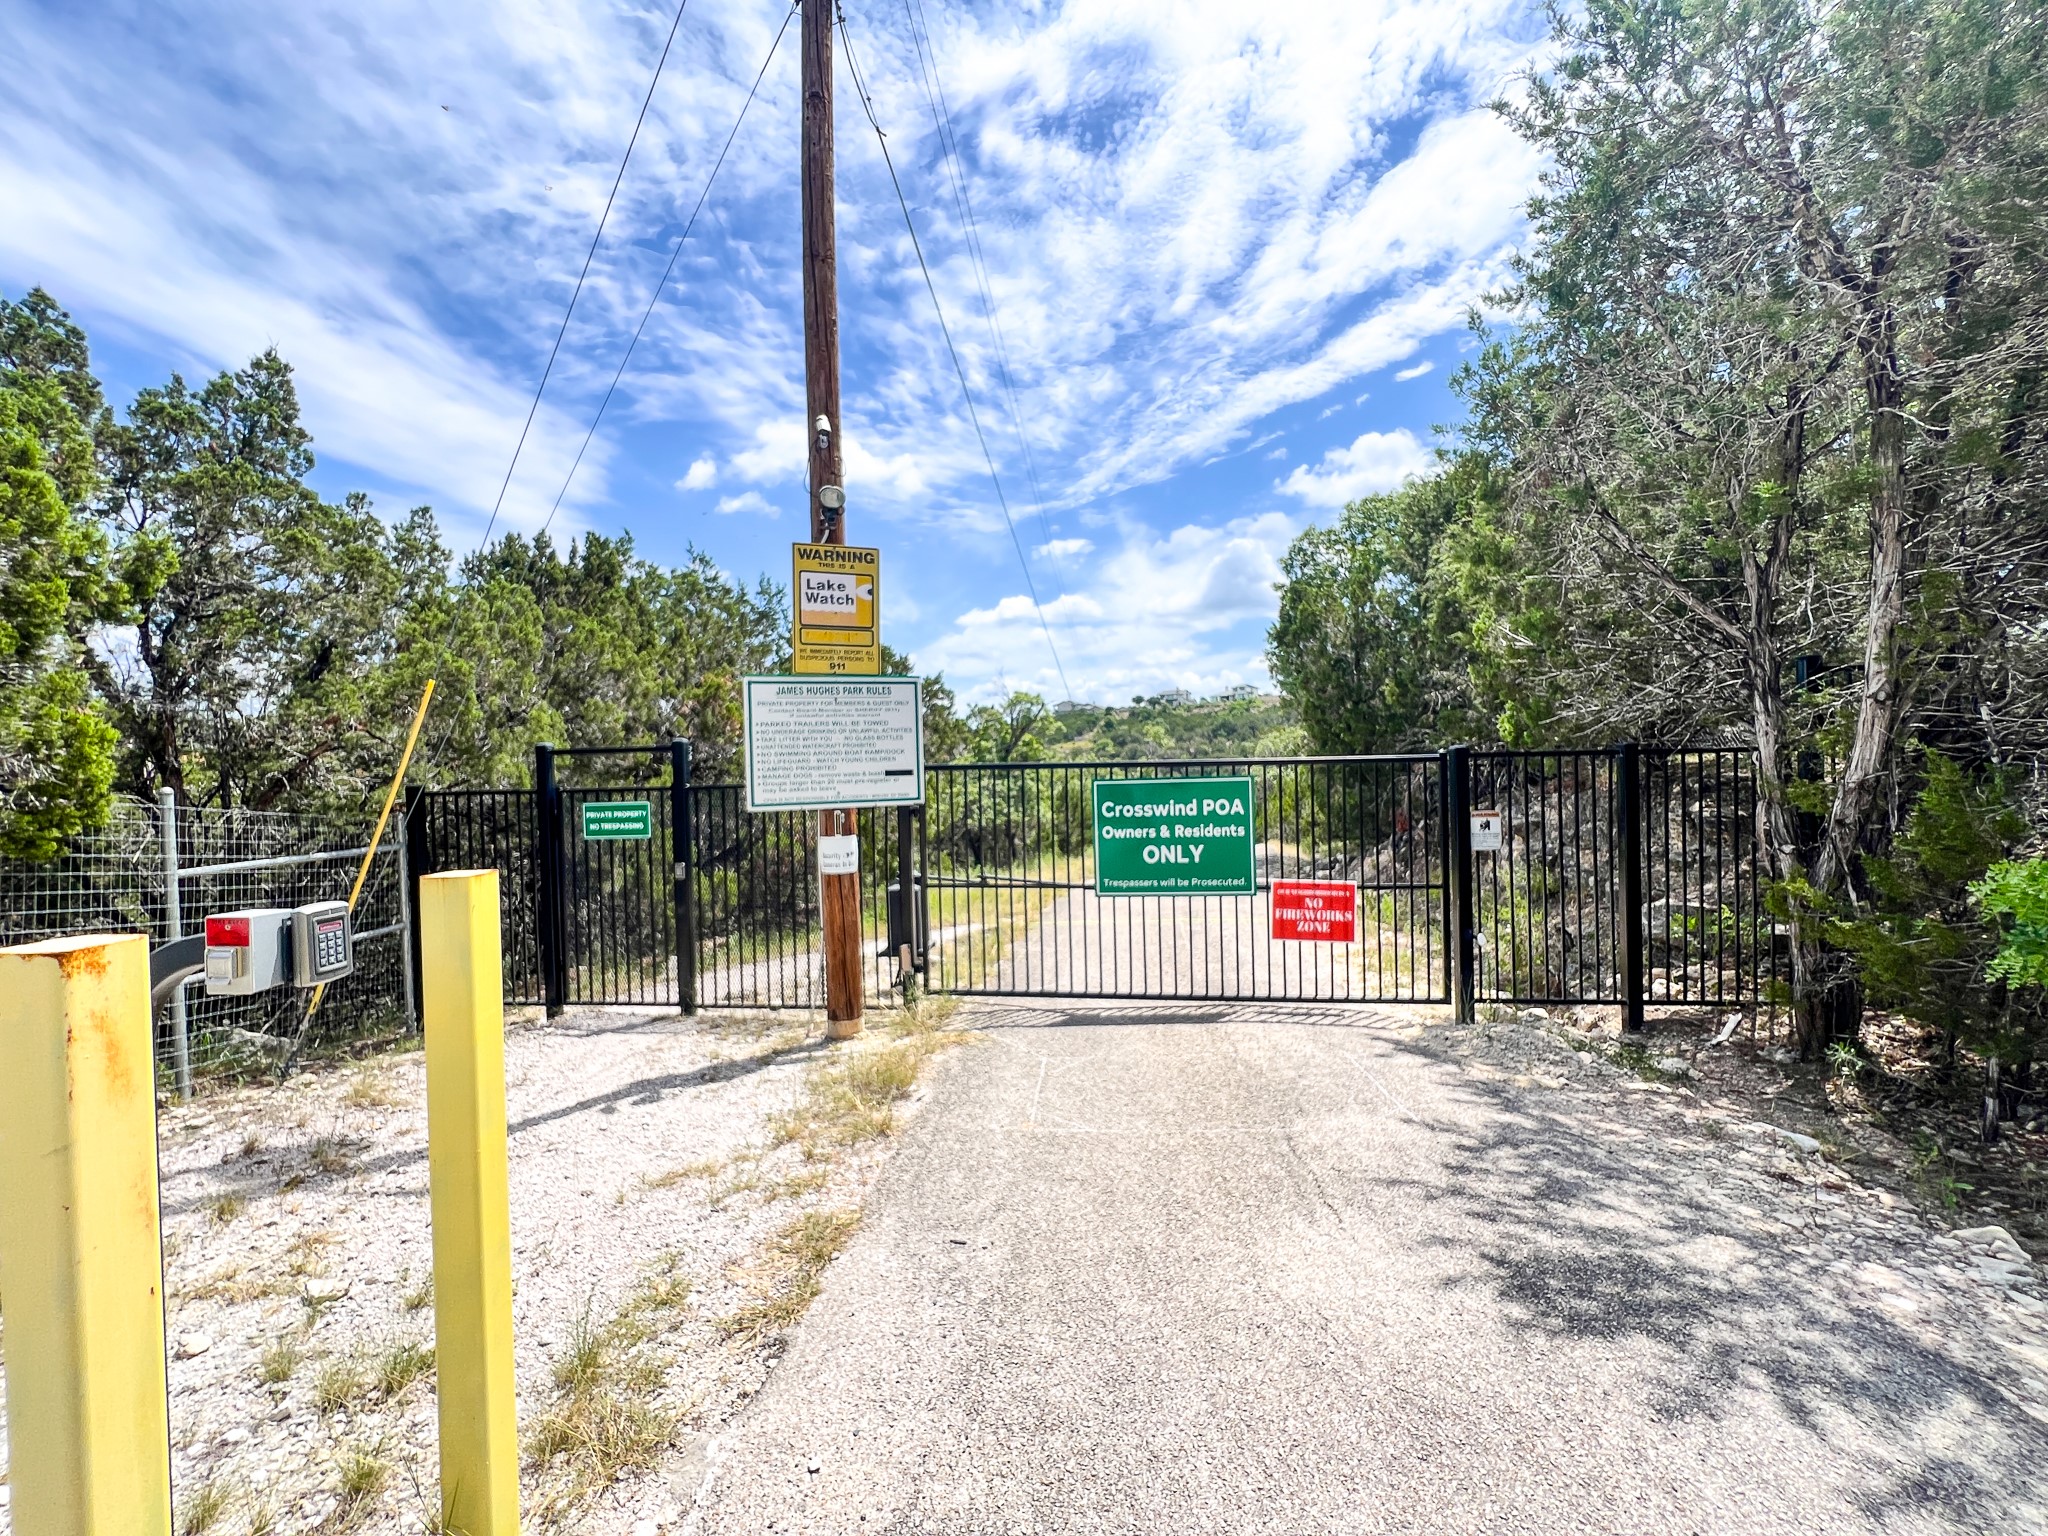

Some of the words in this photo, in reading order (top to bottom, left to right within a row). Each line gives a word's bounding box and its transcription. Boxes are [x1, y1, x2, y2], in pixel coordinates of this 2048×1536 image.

[798, 547, 875, 564] WARNING
[806, 578, 846, 592] Lake
[805, 592, 854, 606] Watch
[829, 662, 846, 670] 911
[776, 686, 804, 696] JAMES
[806, 686, 840, 696] HUGHES
[843, 686, 864, 695] PARK
[866, 686, 892, 695] RULES
[586, 810, 613, 818] PRIVATE
[613, 810, 647, 818] PROPERTY
[1101, 798, 1198, 818] Crosswind
[1202, 798, 1245, 816] POA
[589, 822, 600, 830] NO
[600, 821, 644, 830] TRESPASSING
[1102, 825, 1157, 839] Owners
[1160, 825, 1170, 838] &
[1175, 822, 1246, 838] Residents
[1142, 844, 1205, 865] ONLY
[1103, 878, 1158, 889] Trespassers
[1160, 877, 1175, 887] will
[1177, 877, 1189, 886] be
[1191, 876, 1247, 887] Prosecuted.
[1304, 897, 1323, 909] NO
[1275, 908, 1353, 922] FIREWORKS
[1296, 921, 1331, 933] ZONE
